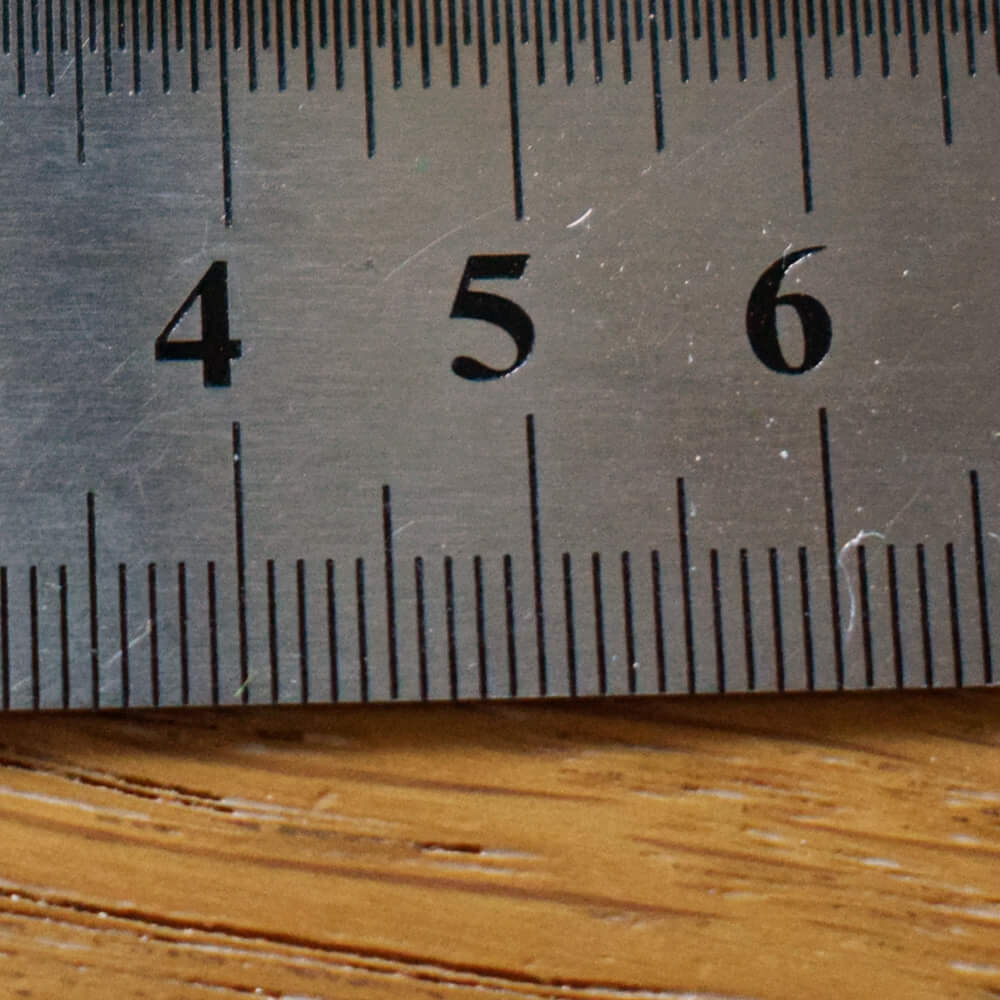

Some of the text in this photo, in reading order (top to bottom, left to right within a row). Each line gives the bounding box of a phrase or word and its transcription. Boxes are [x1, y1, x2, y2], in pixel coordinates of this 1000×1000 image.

[154, 260, 243, 389] 4
[449, 253, 536, 382] 5
[745, 245, 833, 376] 6
